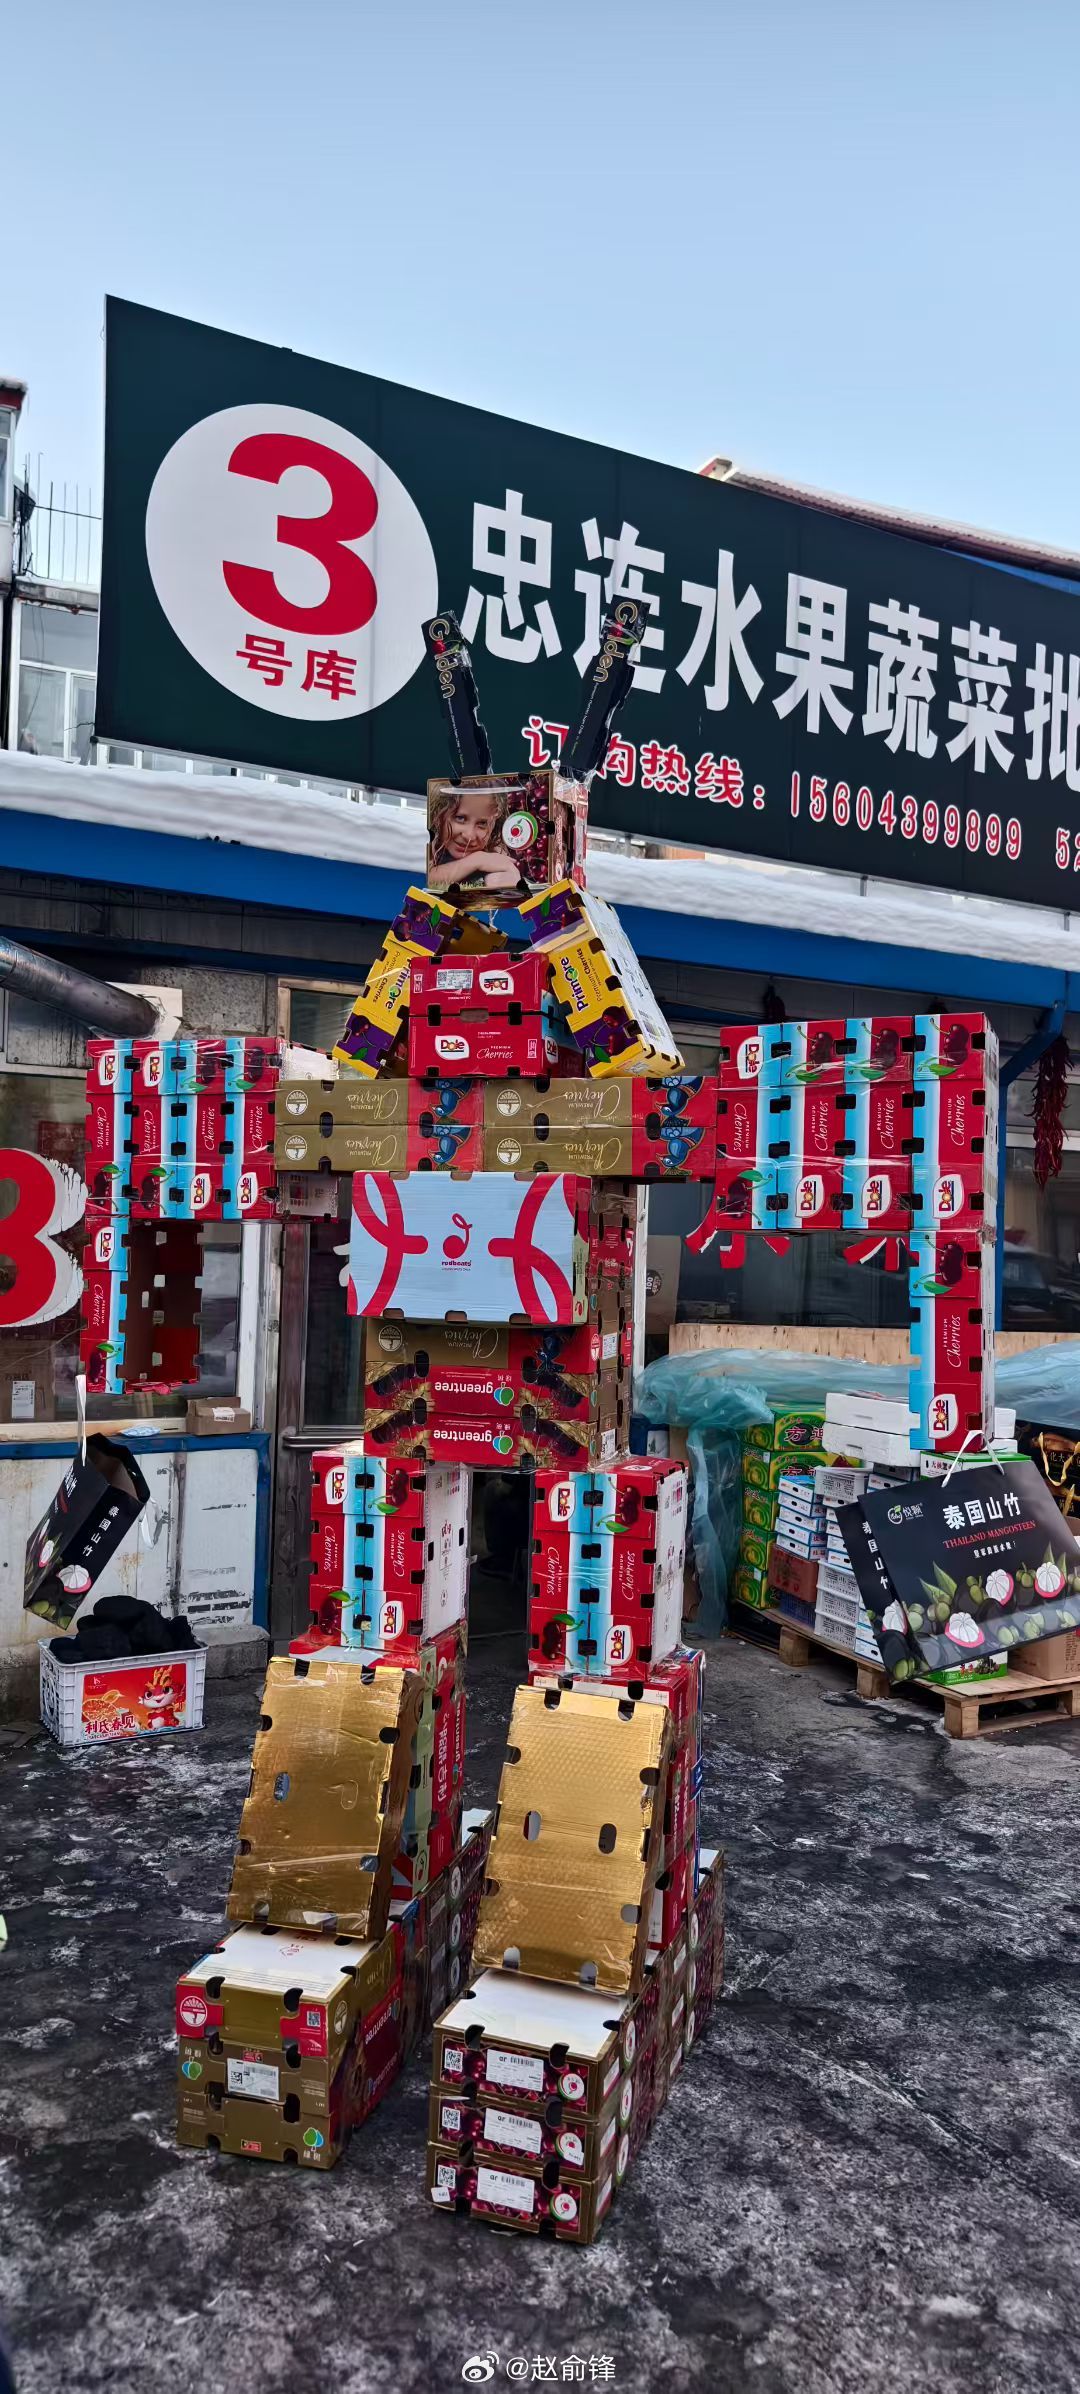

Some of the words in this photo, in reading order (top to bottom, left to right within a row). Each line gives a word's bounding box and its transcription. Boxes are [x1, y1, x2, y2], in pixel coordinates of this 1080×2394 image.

[222, 433, 379, 635] 3
[235, 634, 357, 702] 号库
[791, 771, 1022, 860] 15604399899
[484, 979, 509, 991] Dole
[440, 1039, 465, 1050] Dole
[476, 1047, 514, 1059] Cherries
[748, 1043, 760, 1074] Dole
[106, 1055, 116, 1081] Dole
[97, 1106, 107, 1150] Cherries
[203, 1107, 215, 1150] Cherries
[733, 1102, 748, 1153] Cherries
[814, 1100, 829, 1152] Cherries
[880, 1097, 895, 1149] Cherries
[950, 1093, 966, 1146] Cherries
[193, 1178, 203, 1204] Dole
[241, 1177, 250, 1203] Dole
[800, 1180, 813, 1211] Dole
[867, 1180, 880, 1211] Dole
[938, 1180, 951, 1212] Dole
[103, 1232, 111, 1258] Dole
[92, 1284, 103, 1327] Cherries
[946, 1314, 962, 1368] Cherries
[434, 1381, 494, 1394] greentree
[933, 1399, 946, 1431] Dole
[433, 1429, 493, 1442] greentree
[334, 1472, 345, 1499] Dole
[560, 1488, 570, 1517] Dole
[942, 1492, 1021, 1530] 泰国山竹
[323, 1525, 336, 1572] Cherries
[943, 1532, 987, 1549] THAILAND
[986, 1519, 1037, 1538] MANGOSTEEN
[392, 1529, 405, 1577] Cherries
[546, 1546, 560, 1597] Cherries
[621, 1550, 636, 1601] Cherries
[384, 1605, 395, 1634] Dole
[611, 1629, 623, 1660] Dole
